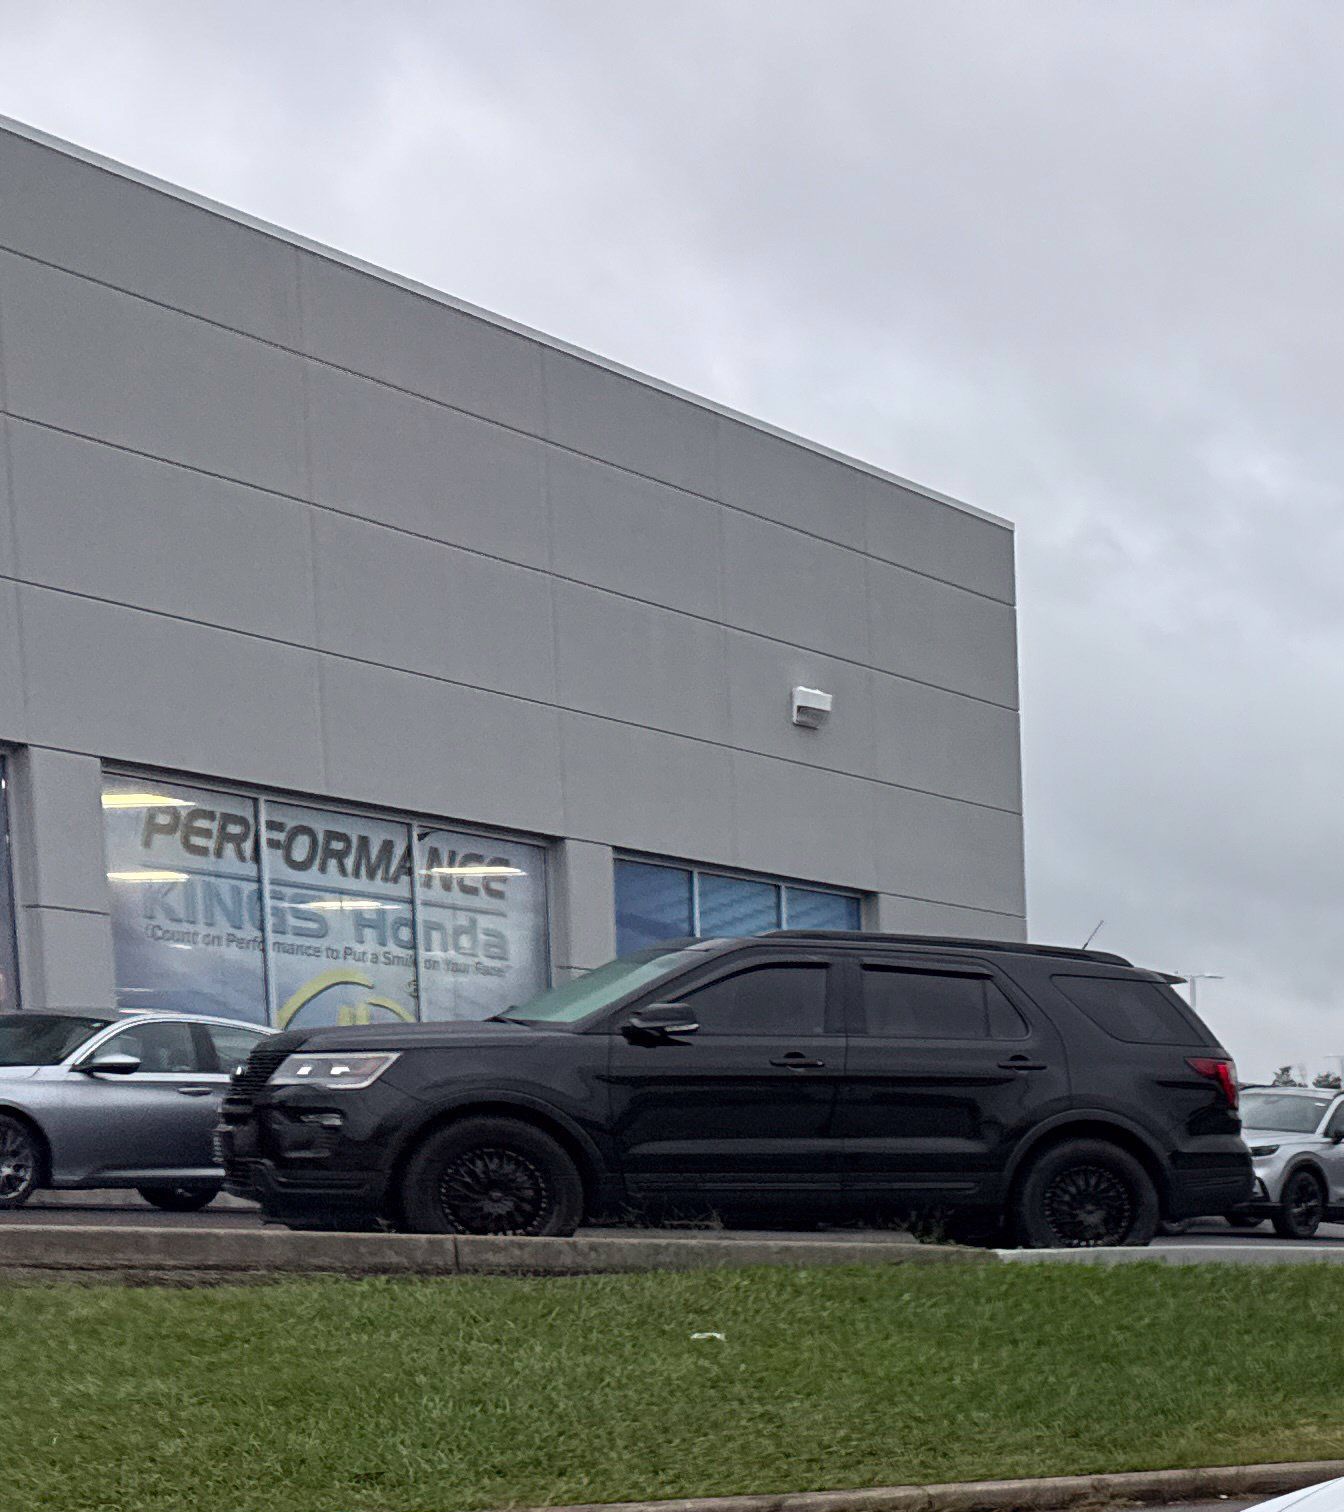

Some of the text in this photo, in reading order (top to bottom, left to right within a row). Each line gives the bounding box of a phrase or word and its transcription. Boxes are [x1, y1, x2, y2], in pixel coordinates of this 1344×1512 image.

[141, 806, 511, 899] PERFORMANCE
[144, 876, 509, 961] KINGS Honda
[326, 944, 339, 961] to
[343, 945, 365, 963] Put
[369, 951, 379, 964] a
